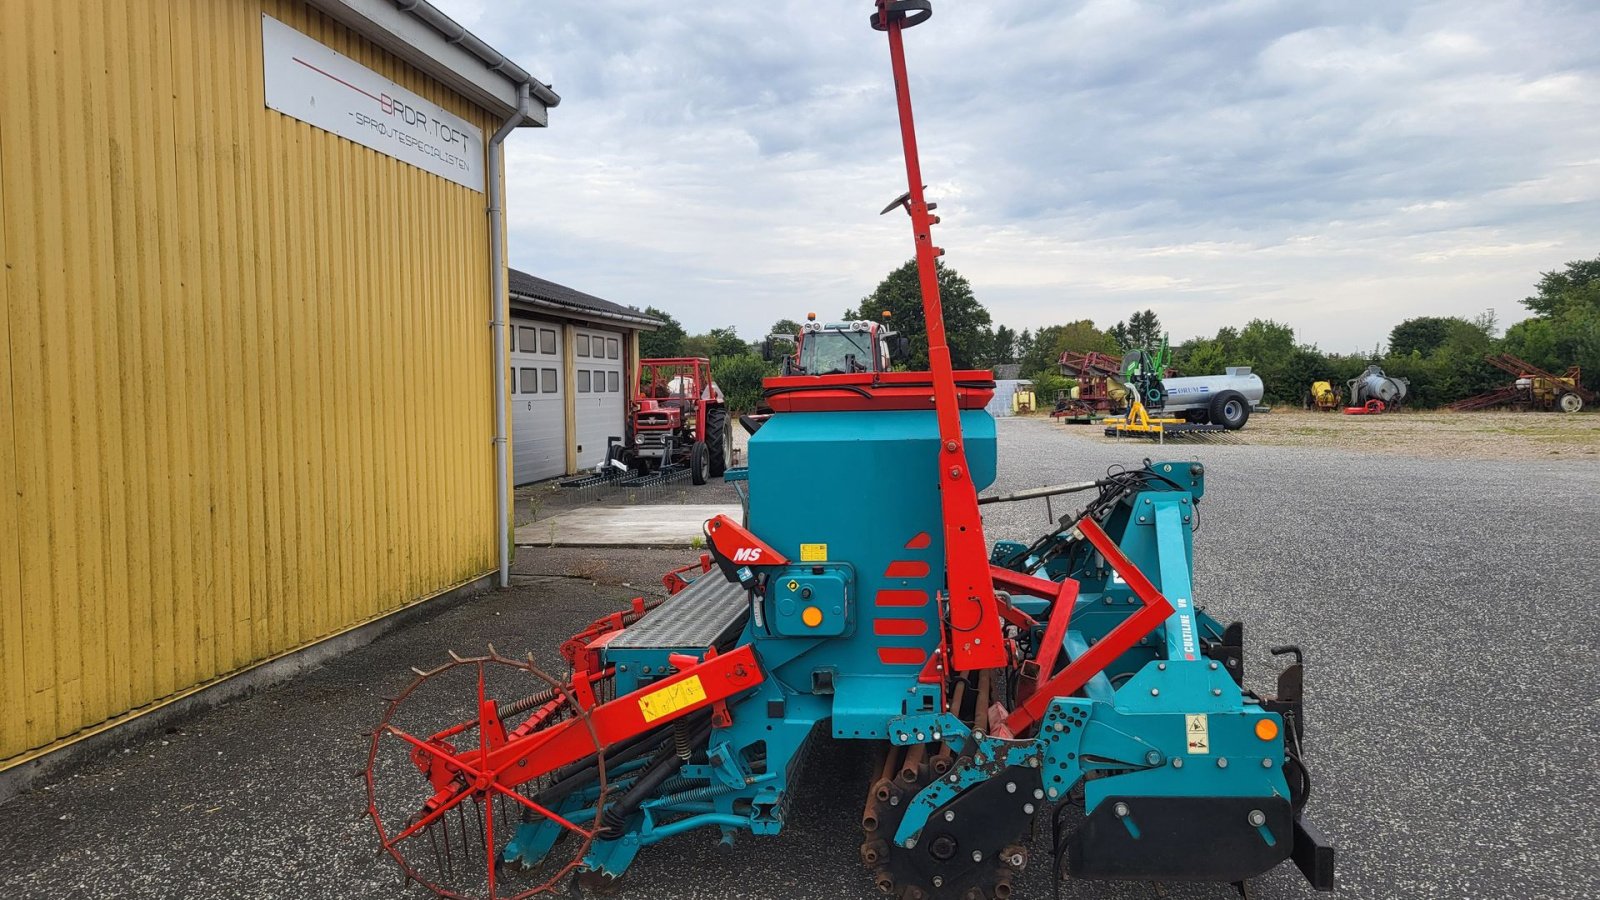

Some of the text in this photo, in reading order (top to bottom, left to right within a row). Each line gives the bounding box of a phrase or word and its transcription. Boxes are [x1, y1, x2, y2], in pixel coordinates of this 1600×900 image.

[527, 400, 532, 412] 6
[733, 547, 762, 562] MS
[1177, 598, 1194, 653] CULTILINE VR
